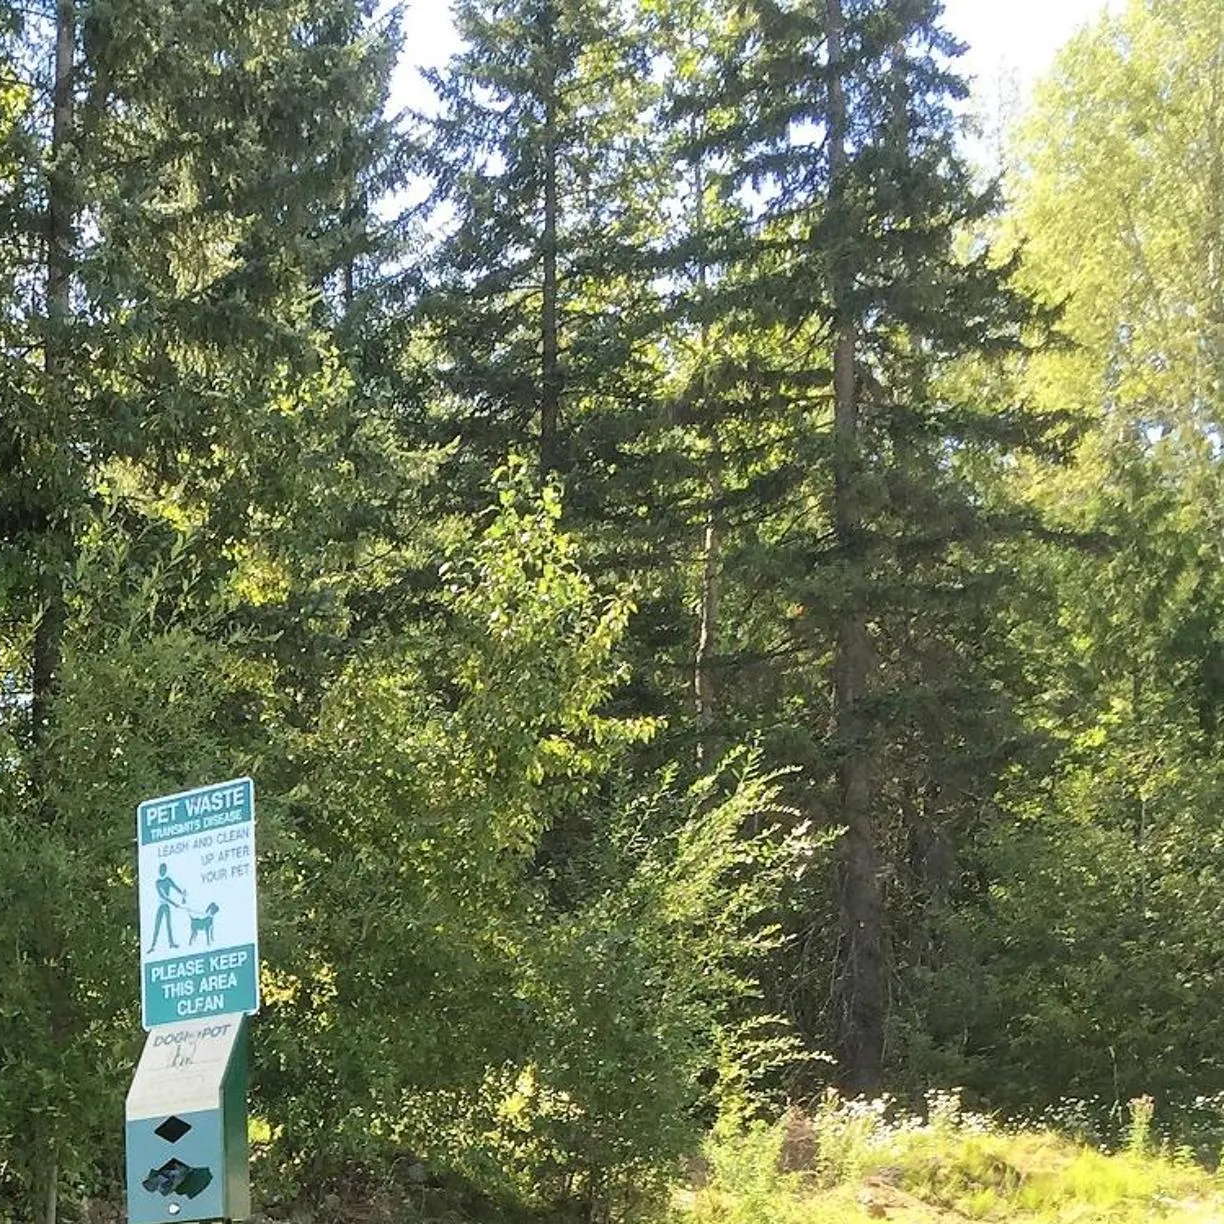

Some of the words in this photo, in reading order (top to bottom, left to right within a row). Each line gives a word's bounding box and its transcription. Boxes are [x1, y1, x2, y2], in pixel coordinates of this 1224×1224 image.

[147, 803, 179, 826] PET
[185, 787, 244, 817] WASTE
[151, 820, 201, 840] TRANSMITS
[203, 810, 242, 828] DISEASE
[158, 842, 189, 858] LEASH
[193, 837, 213, 849] AND
[216, 829, 250, 844] CLEAN
[201, 854, 214, 865] UP
[218, 846, 250, 861] AFTER
[201, 869, 227, 883] YOUR
[231, 864, 250, 878] PET
[151, 959, 205, 982] PLEASE
[210, 952, 247, 972] KEEP
[162, 980, 194, 998] THIS
[199, 973, 237, 993] AREA
[177, 995, 225, 1016] CLEAN
